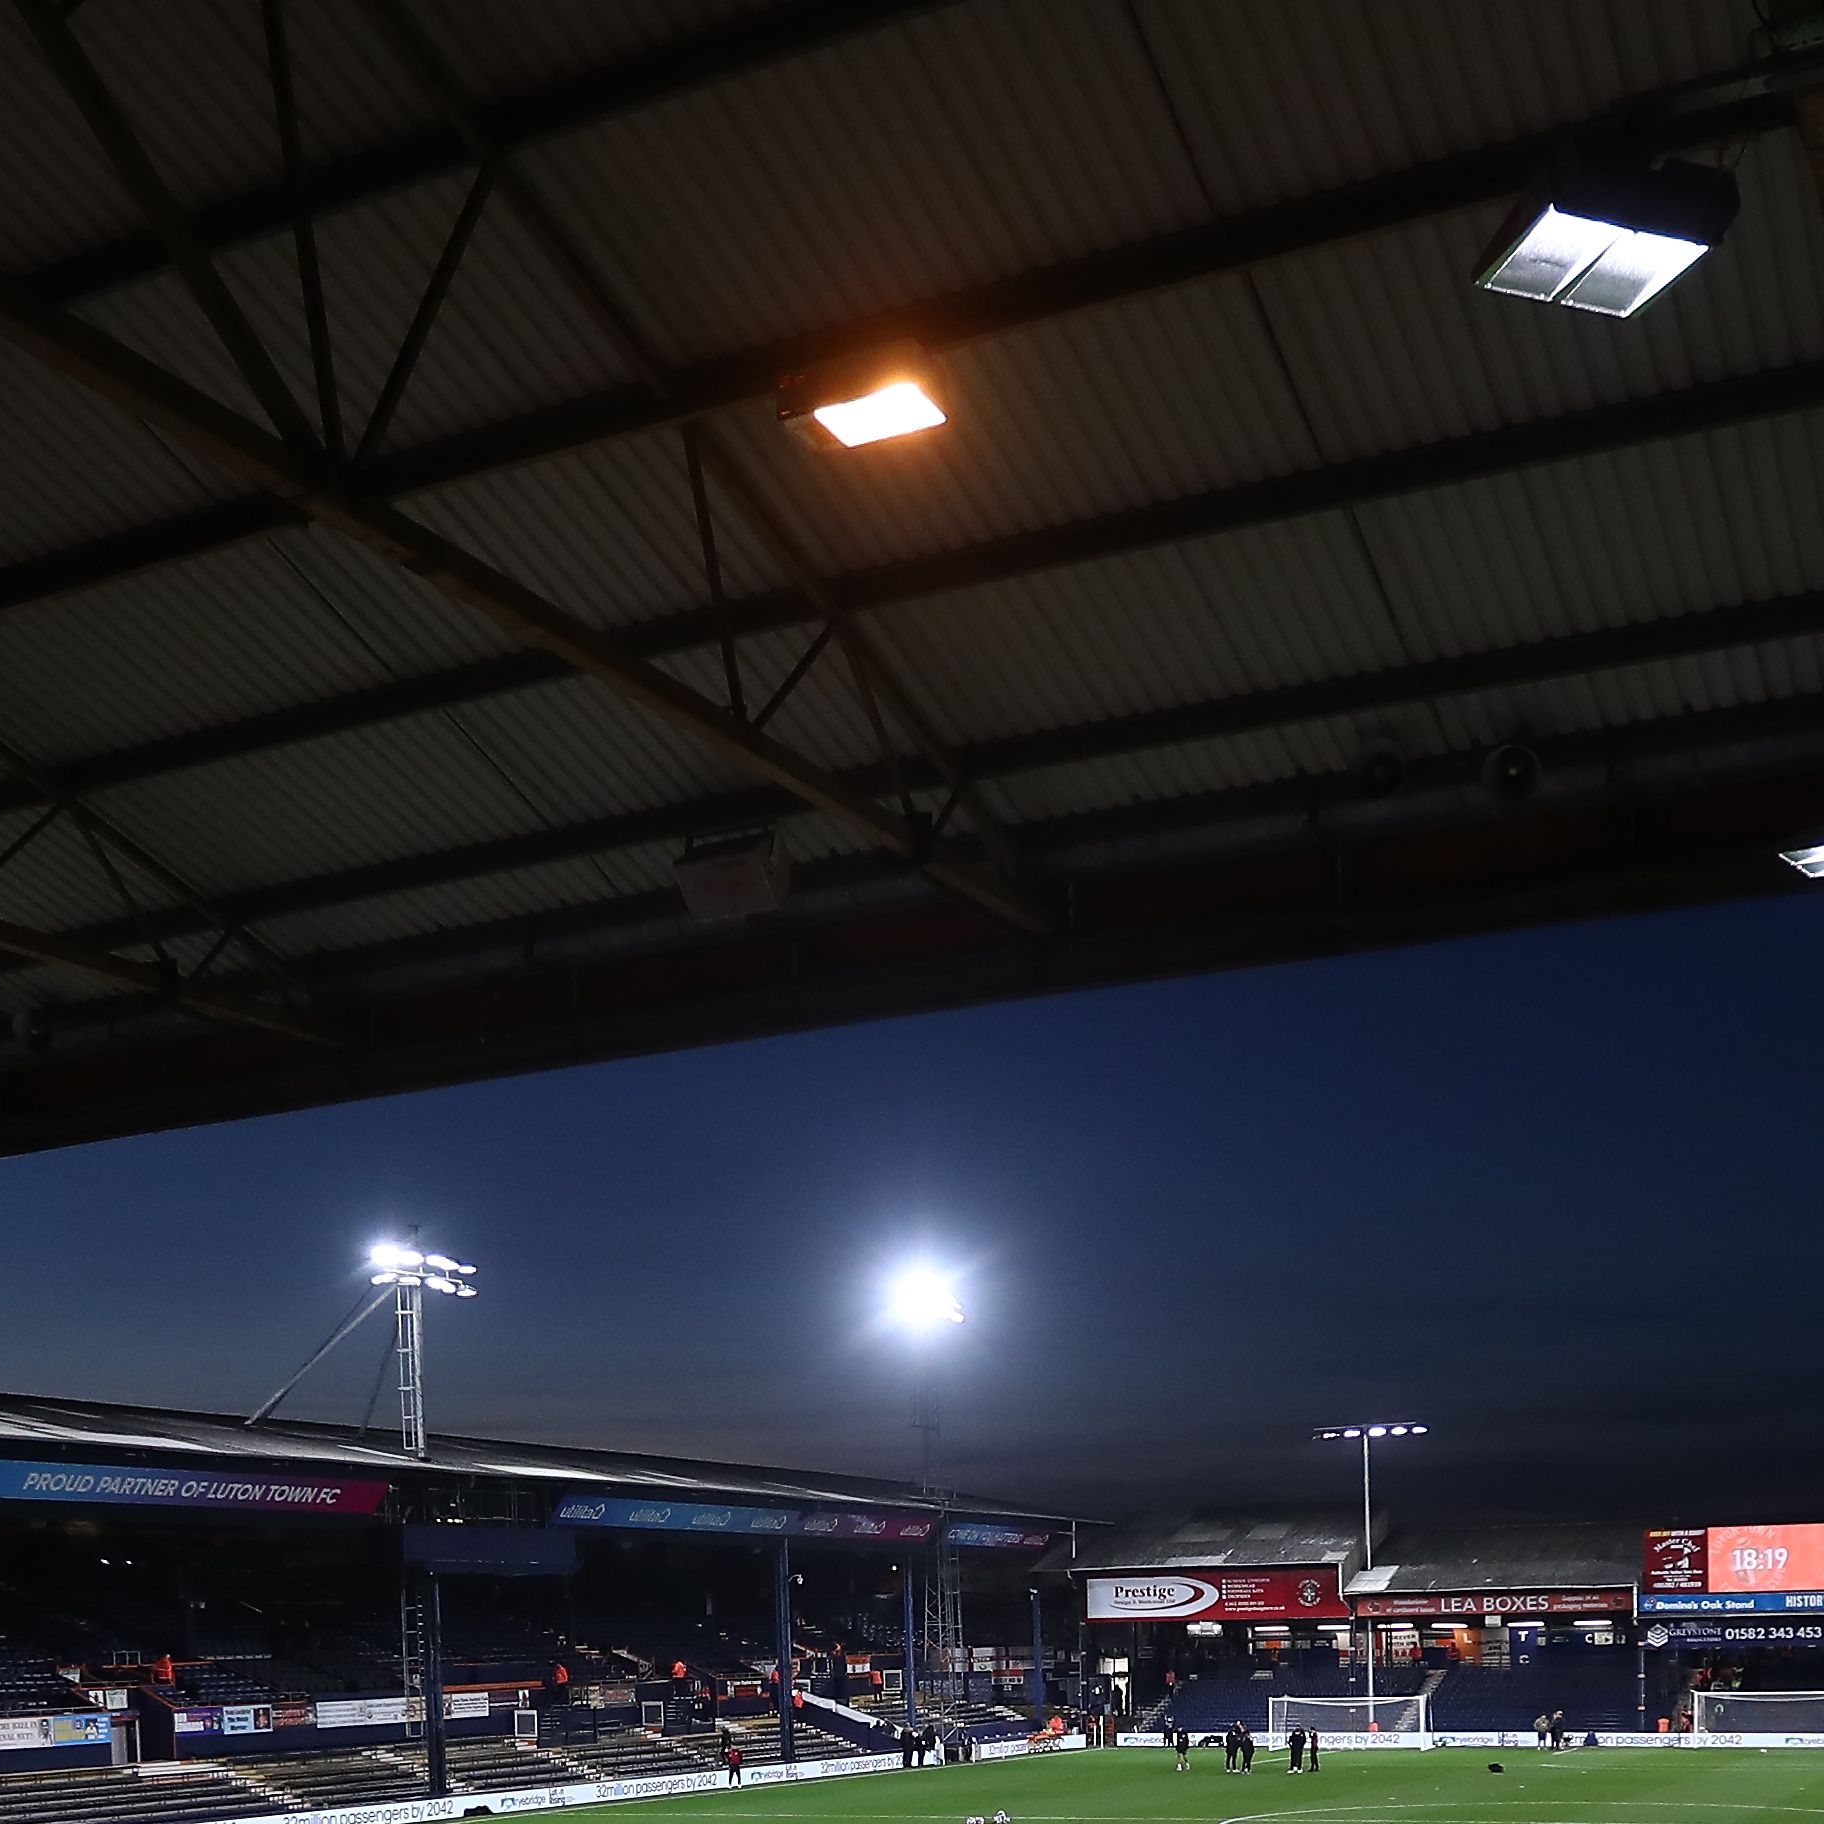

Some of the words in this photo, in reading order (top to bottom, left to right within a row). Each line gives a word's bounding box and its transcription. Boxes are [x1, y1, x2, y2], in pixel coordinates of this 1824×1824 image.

[24, 1473, 94, 1493] PROUD
[96, 1477, 177, 1496] PARTNER
[181, 1480, 206, 1497] OF
[209, 1481, 266, 1501] LUTON
[266, 1485, 318, 1503] TOWN
[318, 1487, 341, 1504] FC
[560, 1504, 593, 1518] utilita
[1732, 1548, 1788, 1570] 18:19
[1114, 1585, 1175, 1600] Prestige
[1441, 1598, 1476, 1612] LEA
[1483, 1595, 1549, 1612] BOXES
[1656, 1600, 1698, 1609] Domino's
[1701, 1600, 1723, 1609] Oak
[1726, 1600, 1754, 1609] Stand
[1518, 1631, 1528, 1641] T
[1585, 1634, 1593, 1643] C
[1669, 1627, 1722, 1636] GREYSTONE
[1726, 1628, 1766, 1640] 01582
[1768, 1628, 1794, 1639] 343
[1796, 1627, 1822, 1638] 453
[1354, 1734, 1368, 1746] by
[1370, 1734, 1400, 1745] 2042
[1616, 1735, 1690, 1747] passengers
[1711, 1734, 1743, 1745] 2042
[820, 1761, 849, 1774] 32million
[850, 1758, 887, 1771] passengers
[887, 1755, 895, 1768] by
[596, 1782, 633, 1798] 32million
[635, 1778, 685, 1796] passengers
[686, 1777, 696, 1791] by
[697, 1774, 717, 1788] 2042
[411, 1804, 425, 1821] by
[427, 1800, 453, 1817] 2042
